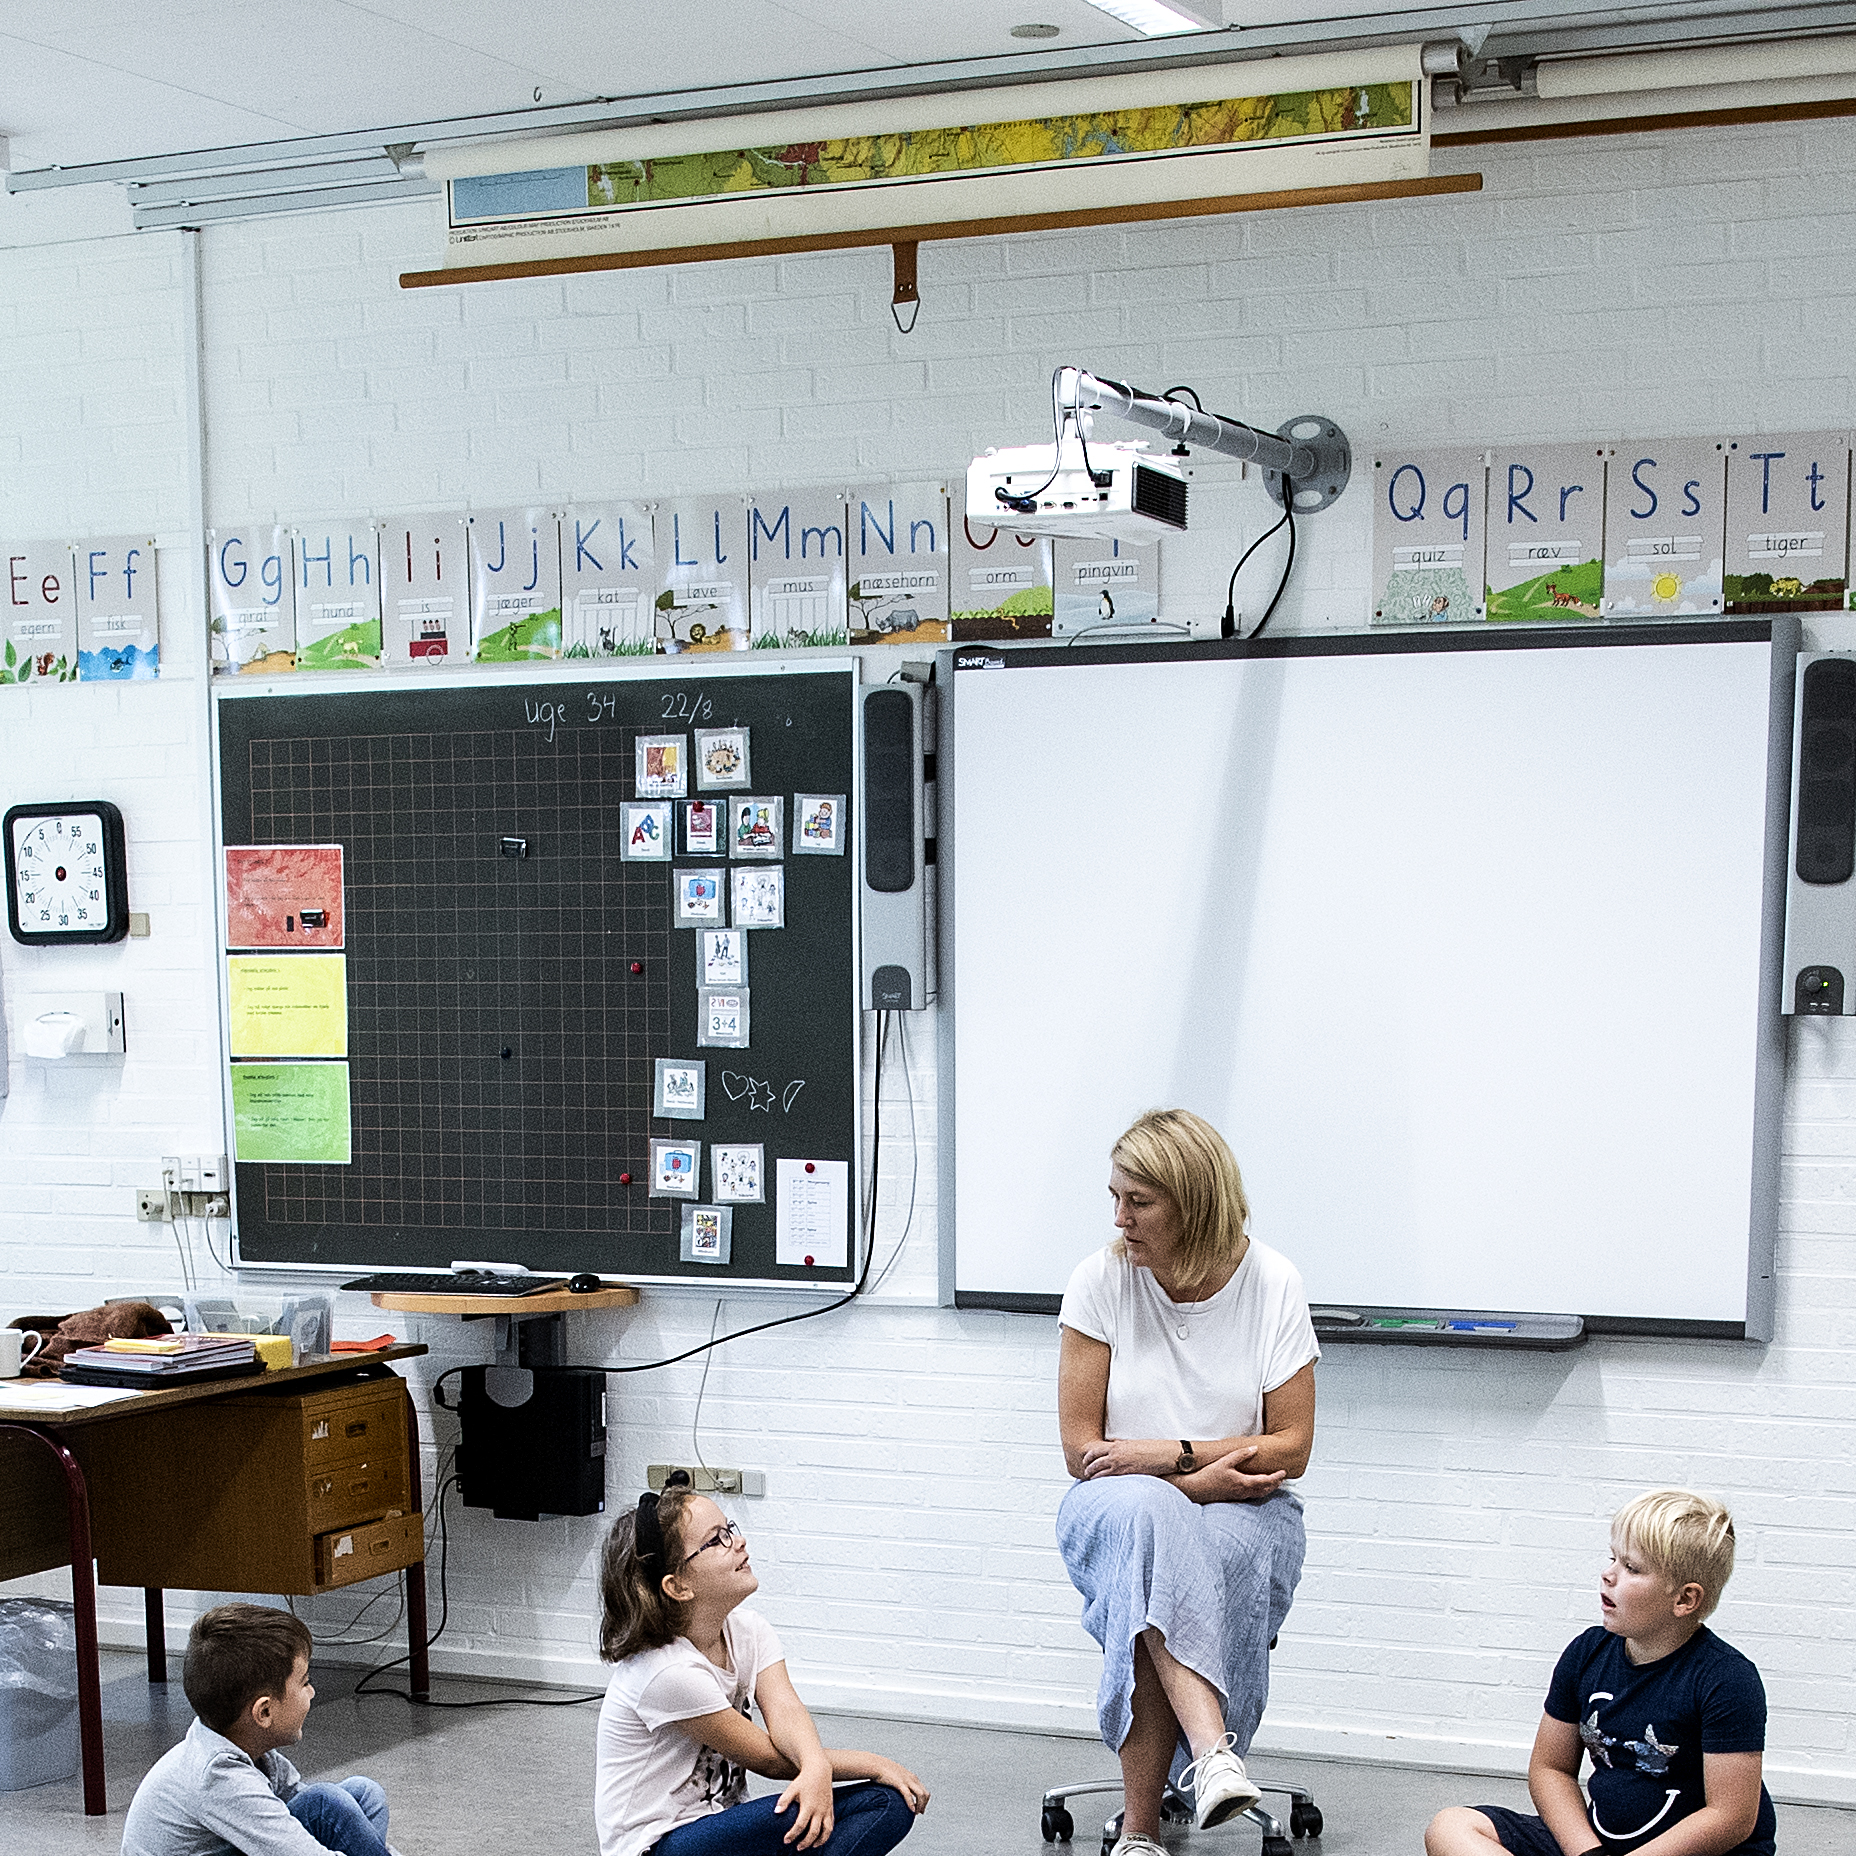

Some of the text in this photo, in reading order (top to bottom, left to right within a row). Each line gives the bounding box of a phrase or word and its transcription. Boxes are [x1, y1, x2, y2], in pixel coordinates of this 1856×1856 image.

[1652, 536, 1677, 556] sol
[1765, 532, 1808, 558] tiger
[1410, 549, 1446, 570] quiz
[1528, 546, 1562, 560] ræv
[986, 570, 1018, 584] orm
[1078, 562, 1135, 585] pingvin
[782, 580, 814, 593] mus
[862, 571, 935, 590] næsehorn
[597, 588, 620, 604] kat
[688, 582, 718, 599] løve
[322, 600, 354, 619] hund
[422, 600, 430, 614] is
[495, 594, 534, 616] jæger
[20, 623, 56, 641] egern
[958, 656, 986, 667] SMART
[586, 692, 616, 722] 34
[660, 692, 713, 724] 22/8
[38, 828, 44, 840] 5
[56, 822, 62, 834] 0
[71, 826, 82, 838] 55
[24, 846, 32, 858] 10
[86, 842, 97, 854] 50
[20, 870, 30, 882] 15
[92, 866, 104, 878] 45
[26, 892, 36, 904] 20
[88, 890, 100, 901] 40
[40, 909, 50, 921] 25
[58, 914, 69, 926] 30
[77, 908, 88, 920] 35
